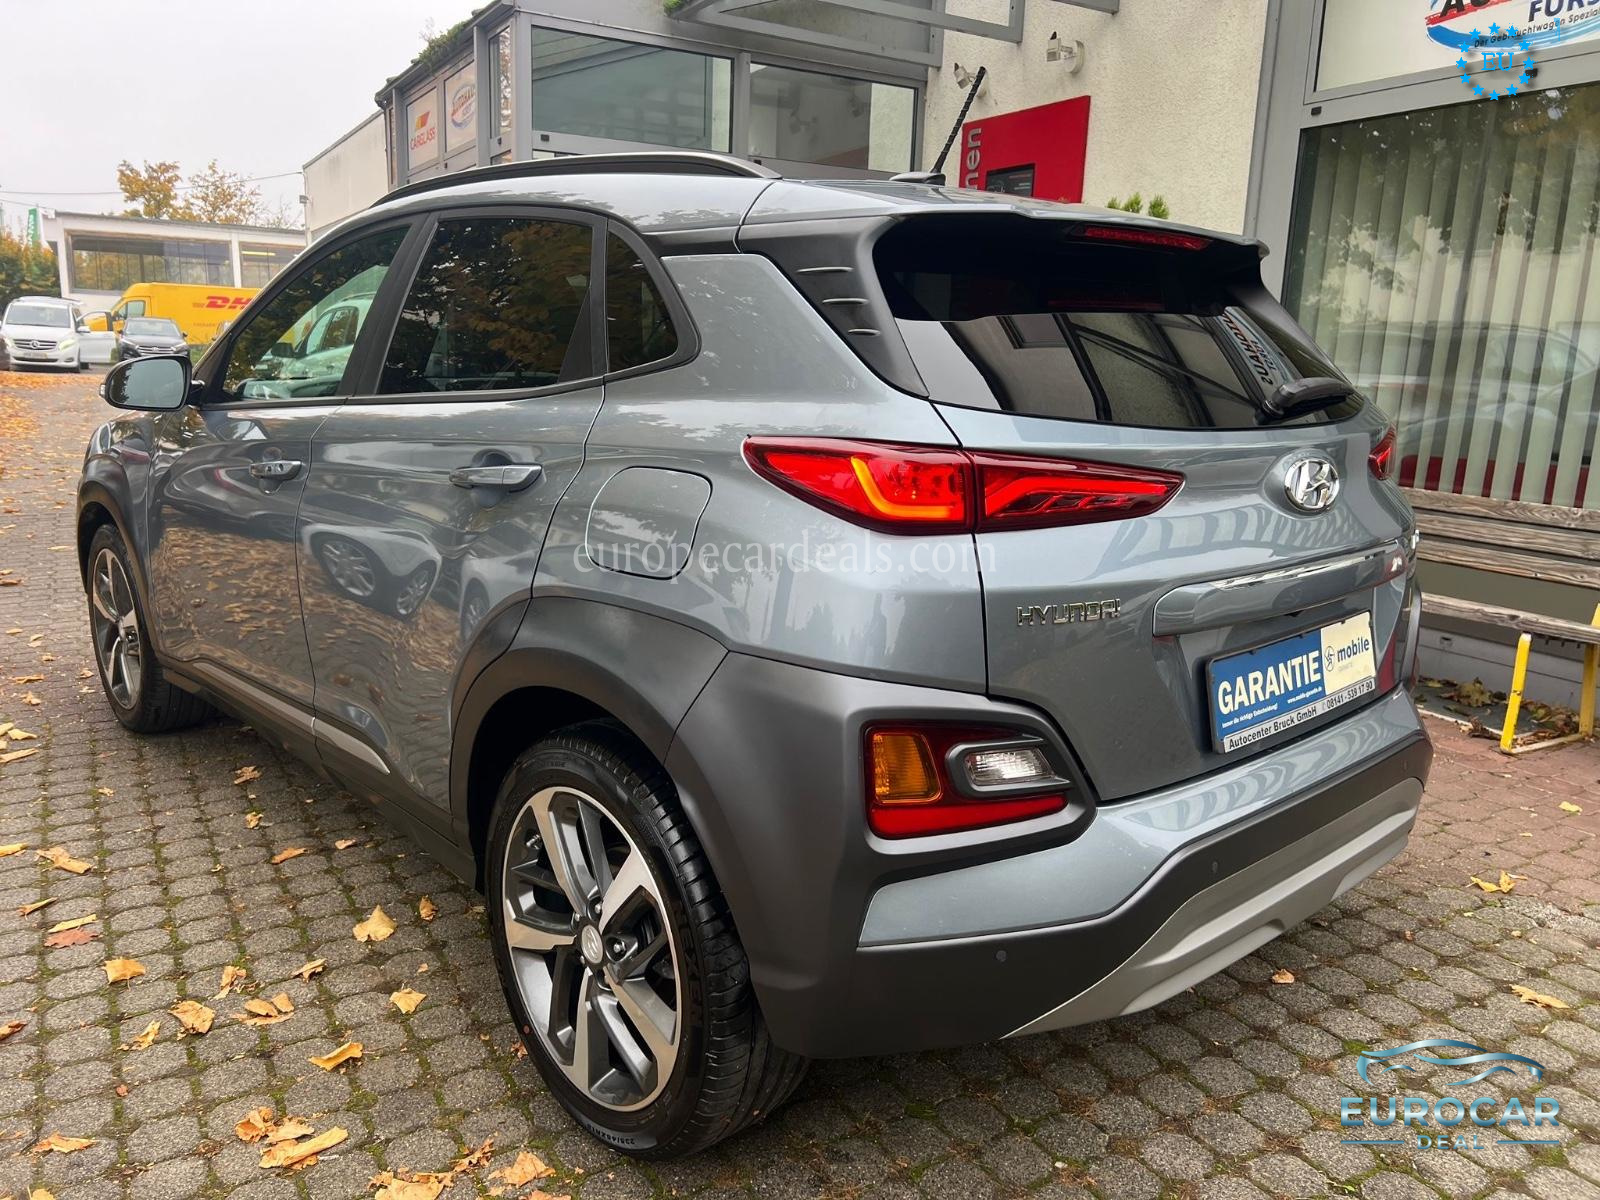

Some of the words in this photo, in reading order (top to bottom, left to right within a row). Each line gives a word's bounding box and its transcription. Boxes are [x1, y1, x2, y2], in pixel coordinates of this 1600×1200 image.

[1017, 598, 1121, 626] HYUNDAI
[1337, 636, 1370, 662] mobile
[1218, 651, 1321, 715] GARANTIE
[1326, 694, 1344, 709] 08141
[1347, 687, 1358, 699] 539
[1358, 684, 1365, 694] 17
[1365, 680, 1373, 691] 90
[1229, 726, 1272, 749] Autocenter
[1273, 715, 1296, 732] Bruck
[1296, 706, 1317, 722] GmbH
